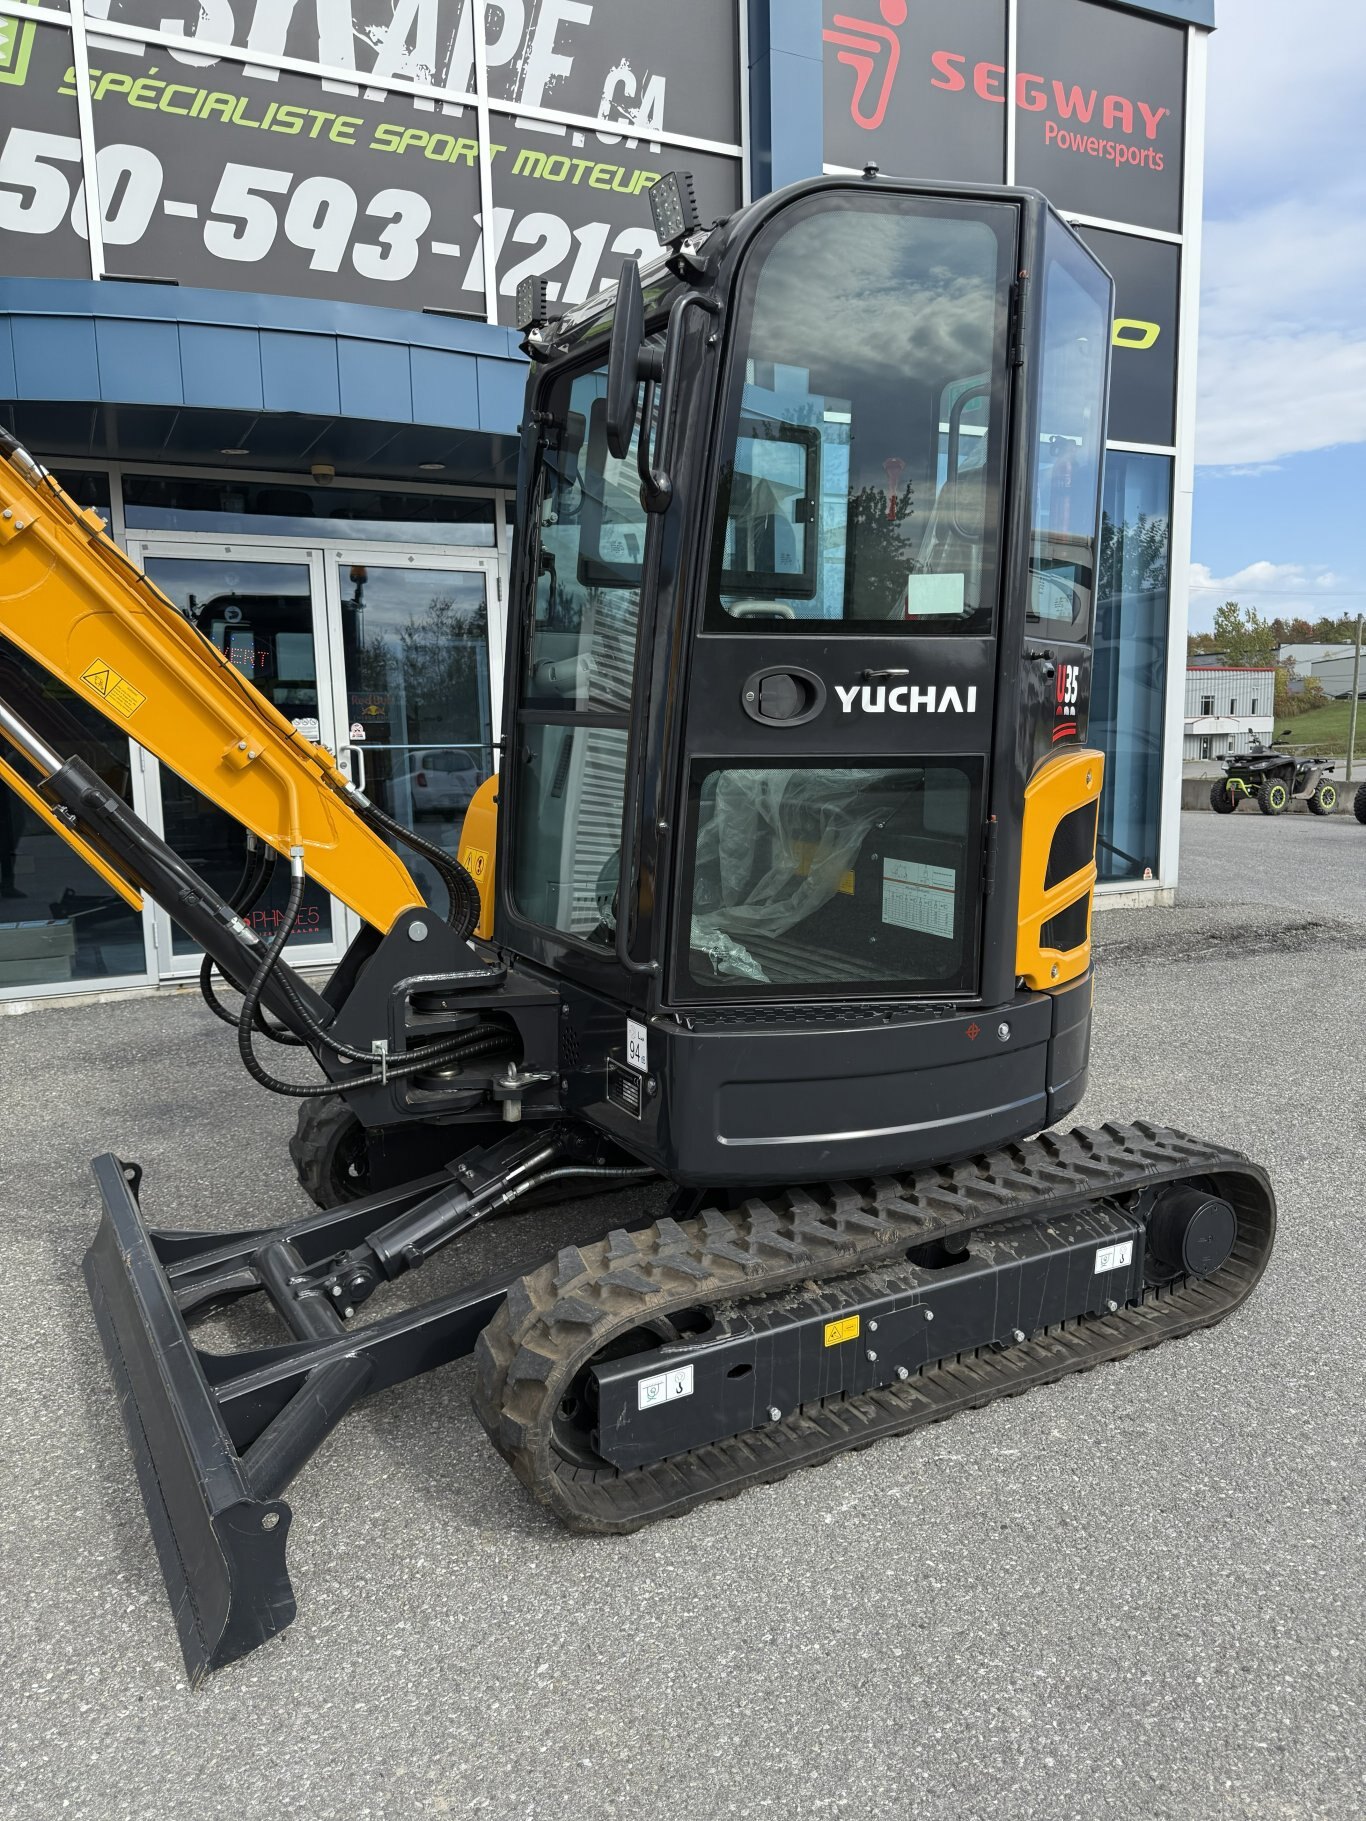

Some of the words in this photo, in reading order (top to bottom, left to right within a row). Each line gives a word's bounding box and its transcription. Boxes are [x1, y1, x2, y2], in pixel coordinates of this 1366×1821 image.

[57, 66, 364, 145] SPÉCIALISTE
[369, 123, 507, 167] SPORT
[1045, 121, 1164, 171] Powersports
[834, 686, 977, 713] YUCHAI
[1056, 664, 1079, 703] U35
[629, 1040, 640, 1062] 94
